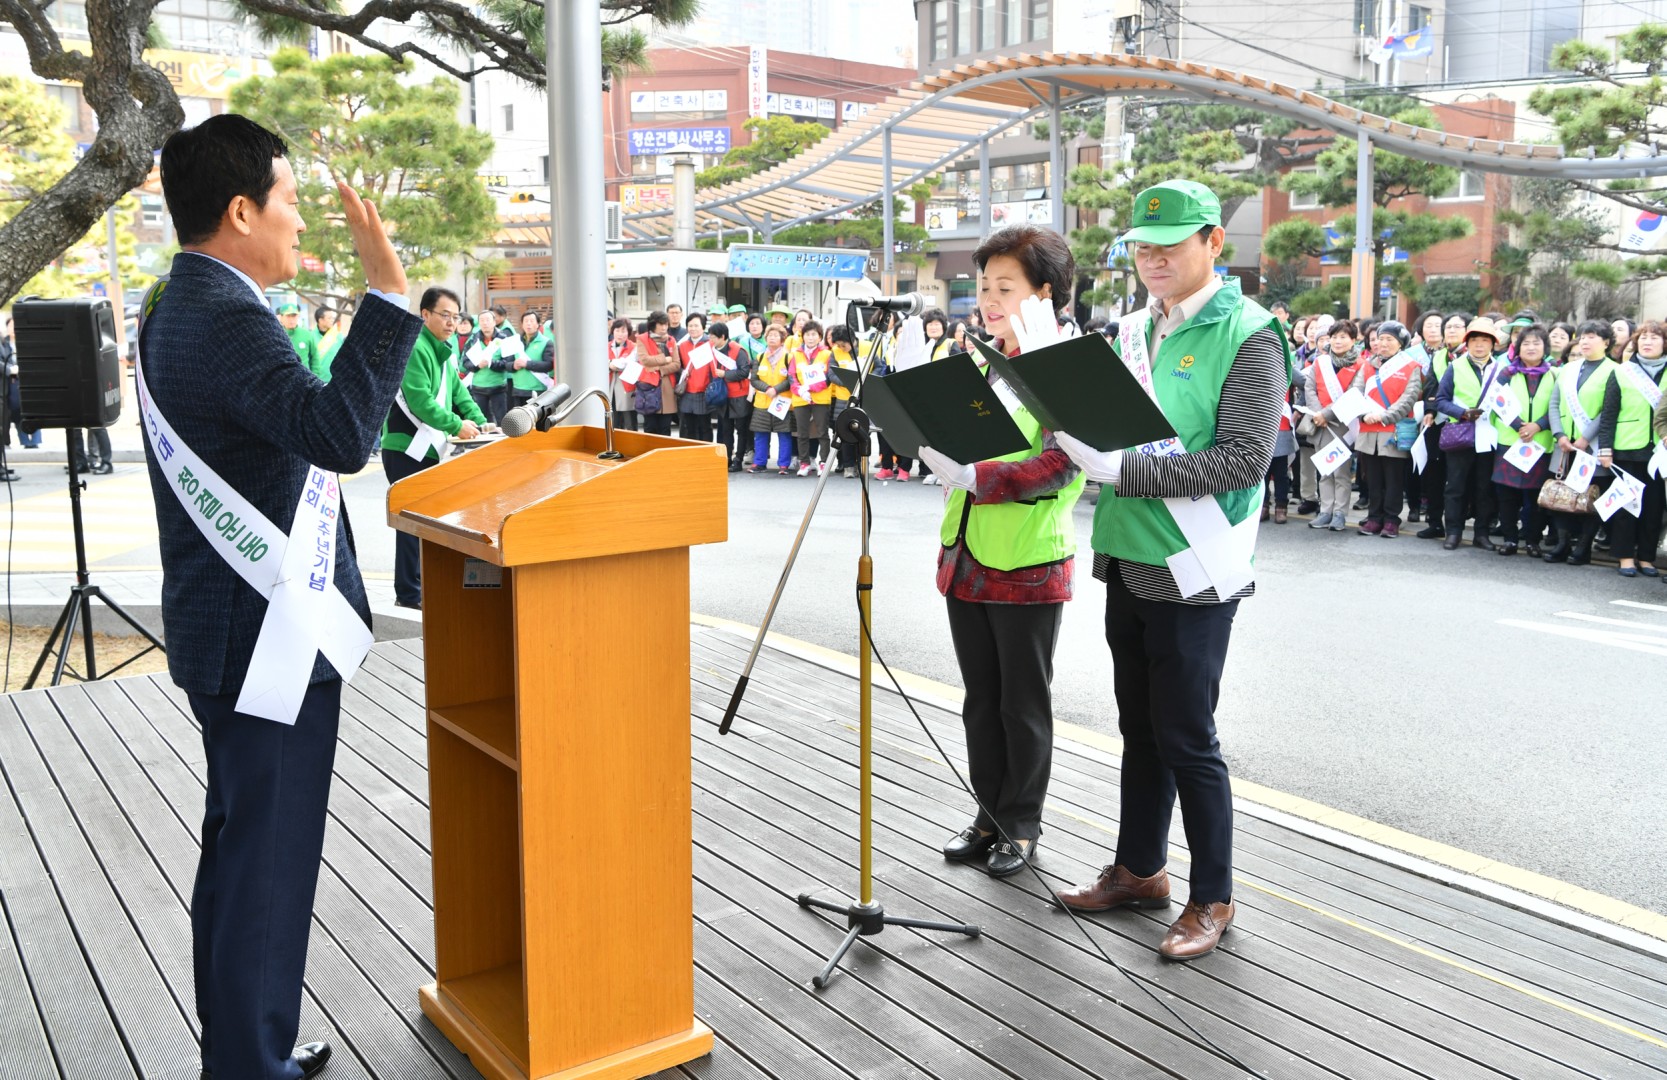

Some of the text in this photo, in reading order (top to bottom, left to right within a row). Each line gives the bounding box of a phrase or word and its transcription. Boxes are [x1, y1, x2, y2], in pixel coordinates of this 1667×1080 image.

[752, 50, 761, 79] 한방
[660, 94, 698, 108] 건축사
[783, 97, 814, 113] 건축사
[640, 188, 672, 202] 부동
[1143, 213, 1161, 221] SMU
[759, 253, 838, 269] Cafe 바다야
[1170, 369, 1192, 381] SMU
[304, 469, 326, 508] 대회
[177, 465, 269, 563] 청결운동
